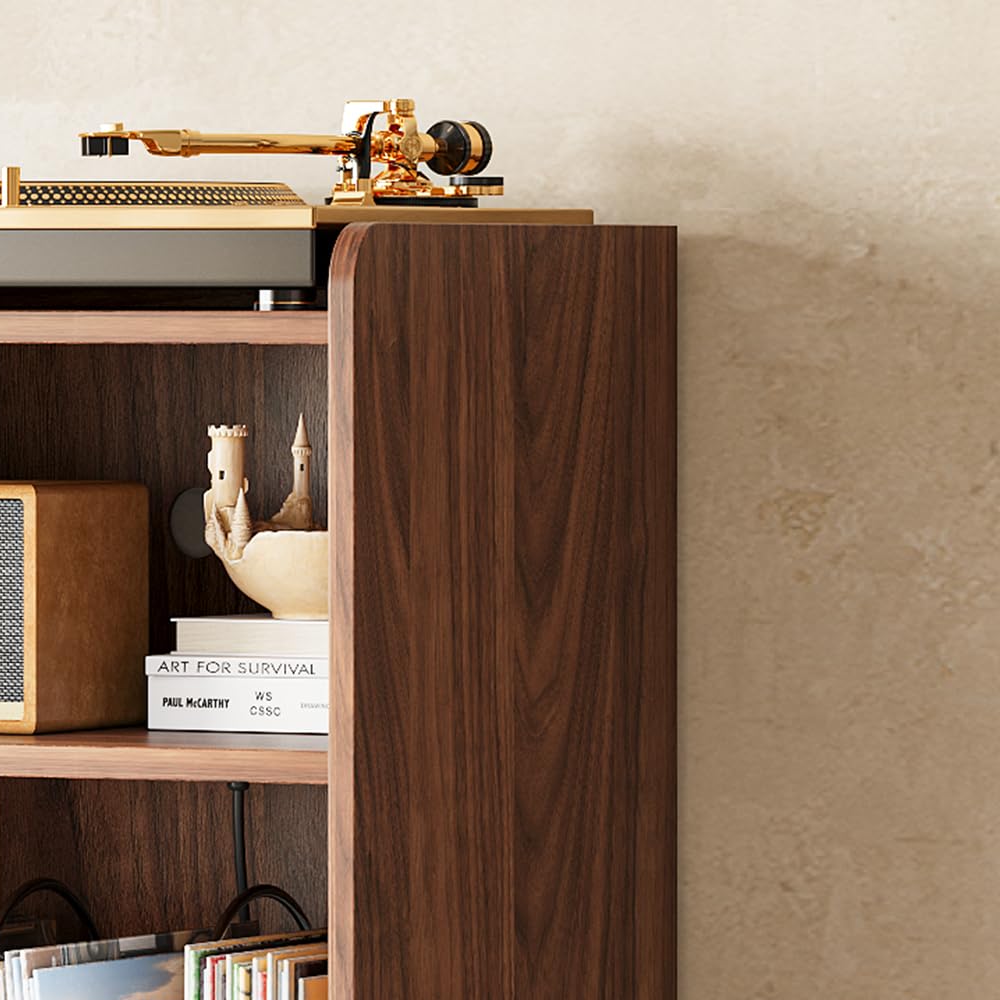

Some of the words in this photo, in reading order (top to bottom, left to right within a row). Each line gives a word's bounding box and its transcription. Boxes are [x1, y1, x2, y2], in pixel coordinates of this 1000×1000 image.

[157, 660, 190, 673] ART
[197, 661, 231, 674] FOR
[238, 662, 317, 675] SURVIVAL
[255, 690, 273, 702] WS
[162, 697, 184, 708] PAUL
[186, 698, 230, 710] McCARTHY
[249, 705, 281, 717] CSSC
